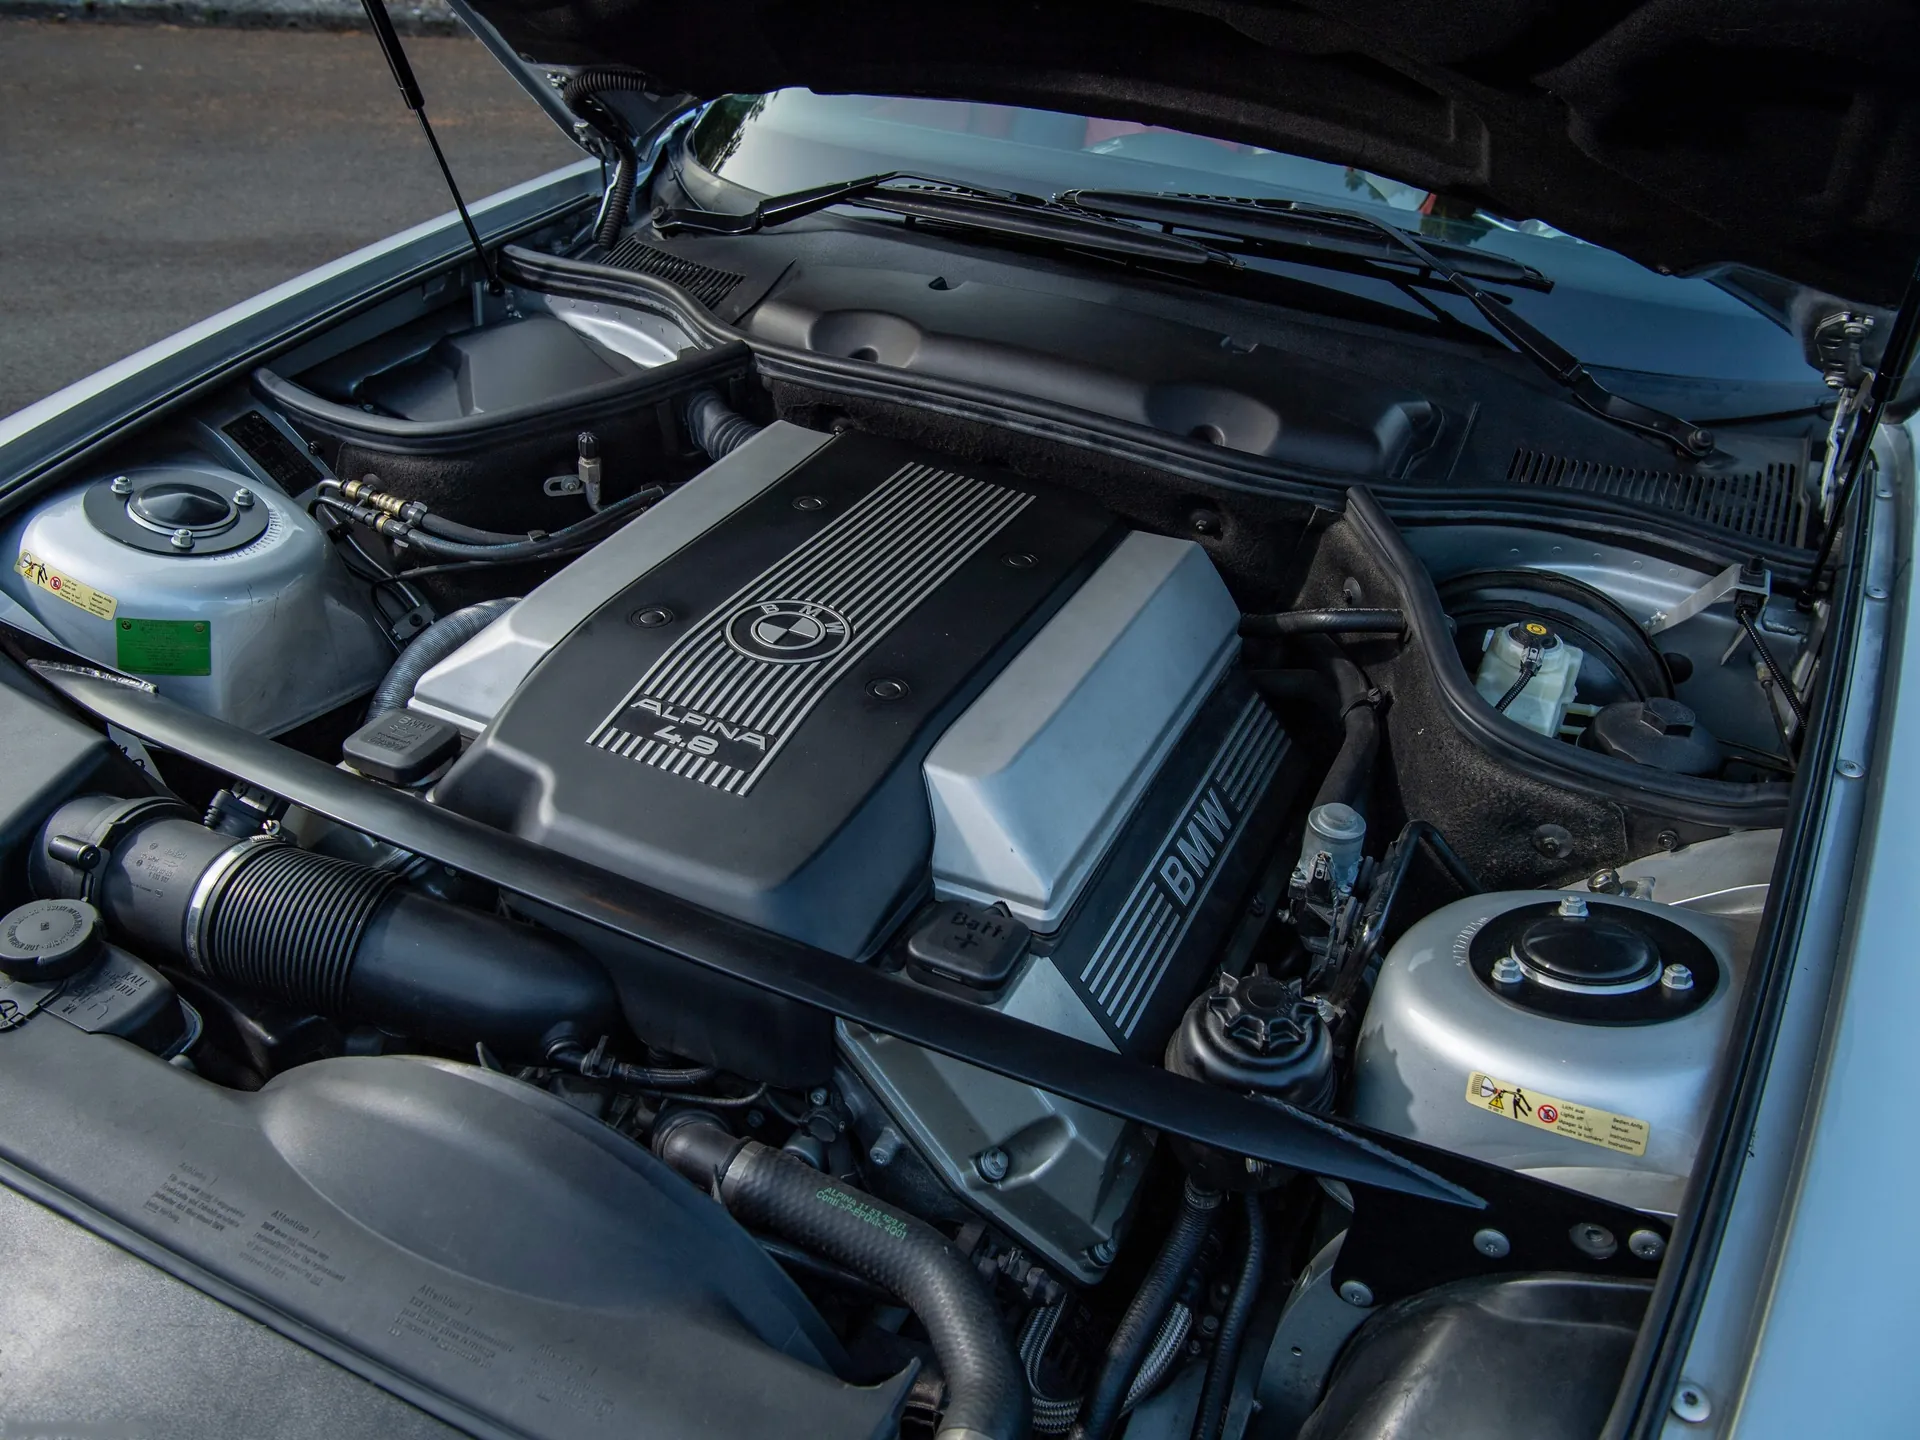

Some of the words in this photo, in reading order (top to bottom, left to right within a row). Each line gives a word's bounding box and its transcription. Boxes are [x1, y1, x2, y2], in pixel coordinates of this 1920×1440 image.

[760, 603, 845, 635] BMW
[630, 697, 768, 750] ALPINA
[654, 726, 720, 756] 4.8
[1159, 788, 1234, 906] BMW
[950, 911, 1006, 941] Batt.
[824, 1187, 857, 1206] ALPINA
[270, 1209, 310, 1234] Attention
[418, 1284, 462, 1310] Attention
